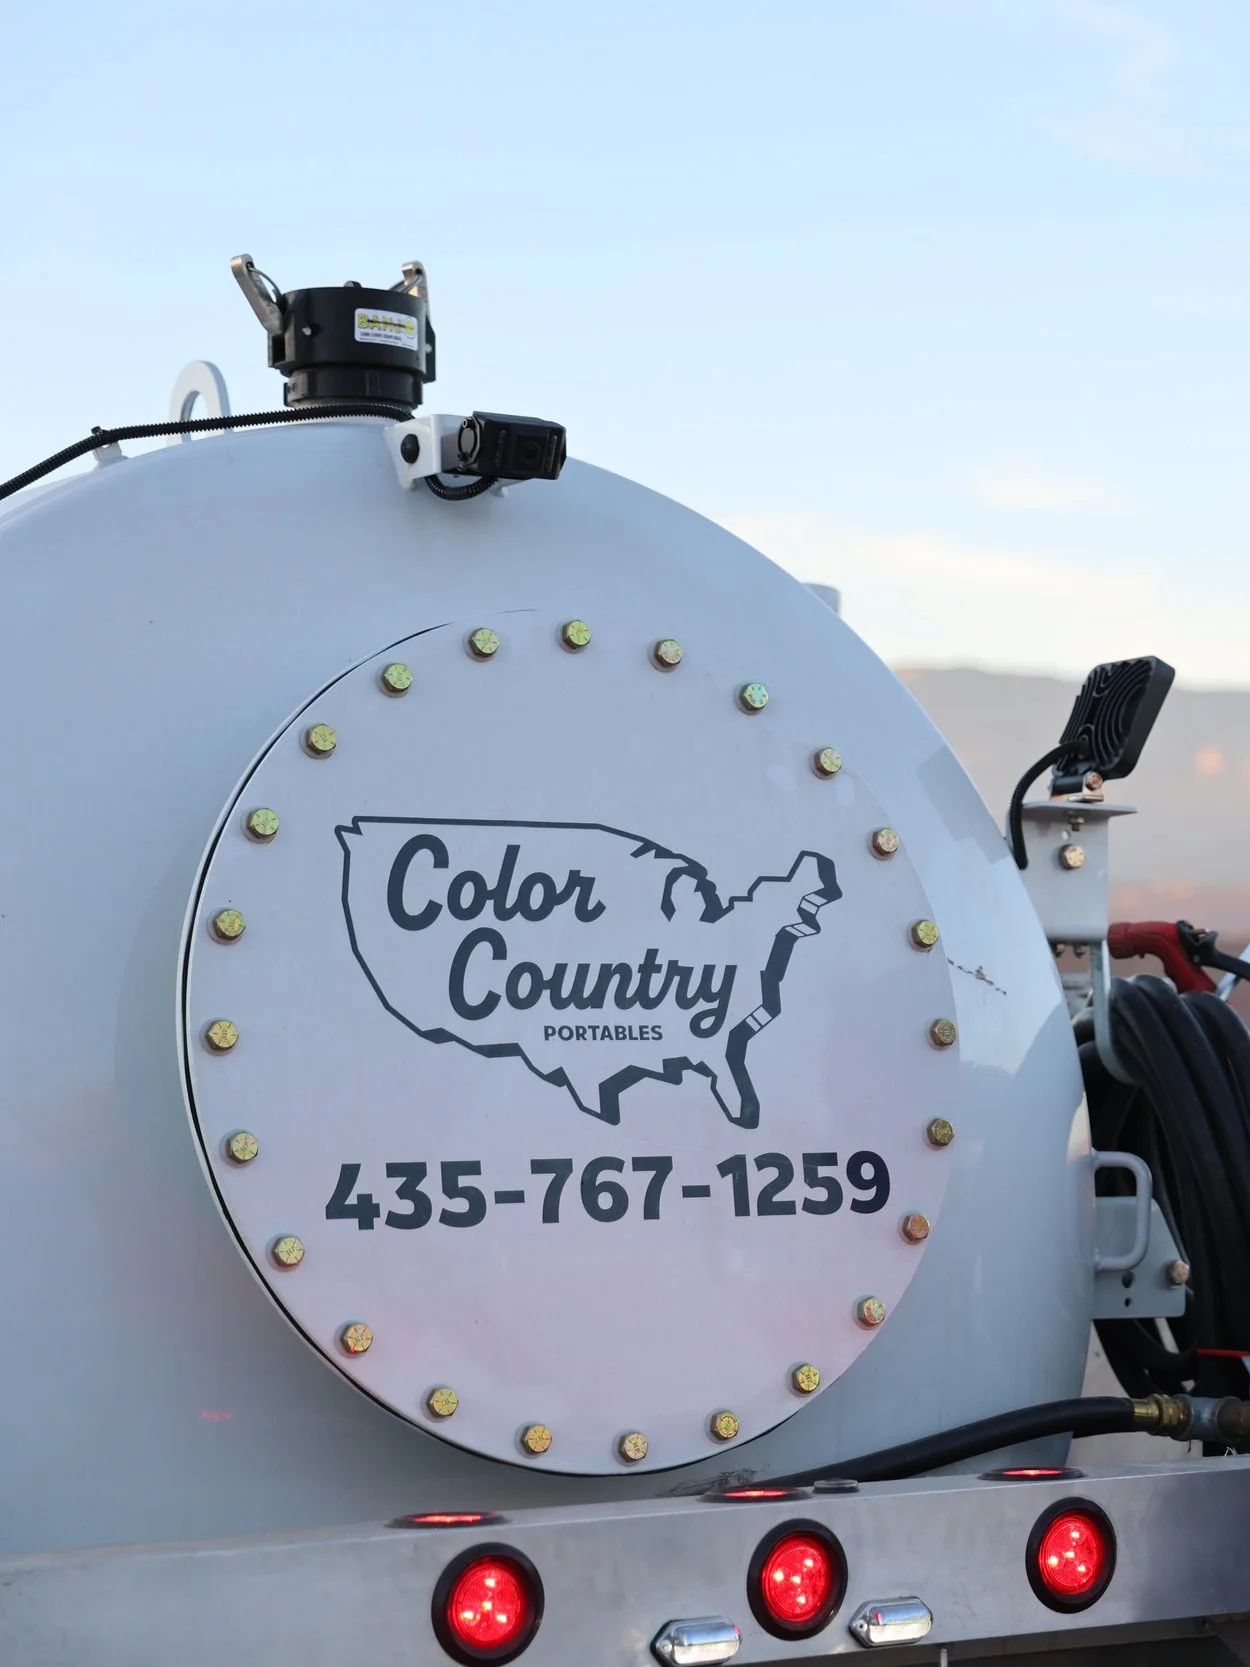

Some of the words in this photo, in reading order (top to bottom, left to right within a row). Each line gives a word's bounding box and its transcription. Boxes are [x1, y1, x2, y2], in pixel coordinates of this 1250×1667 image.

[386, 833, 607, 931] Color
[448, 926, 738, 1039] Country
[543, 1024, 663, 1041] PORTABLES
[324, 1149, 891, 1231] 435-767-1259
